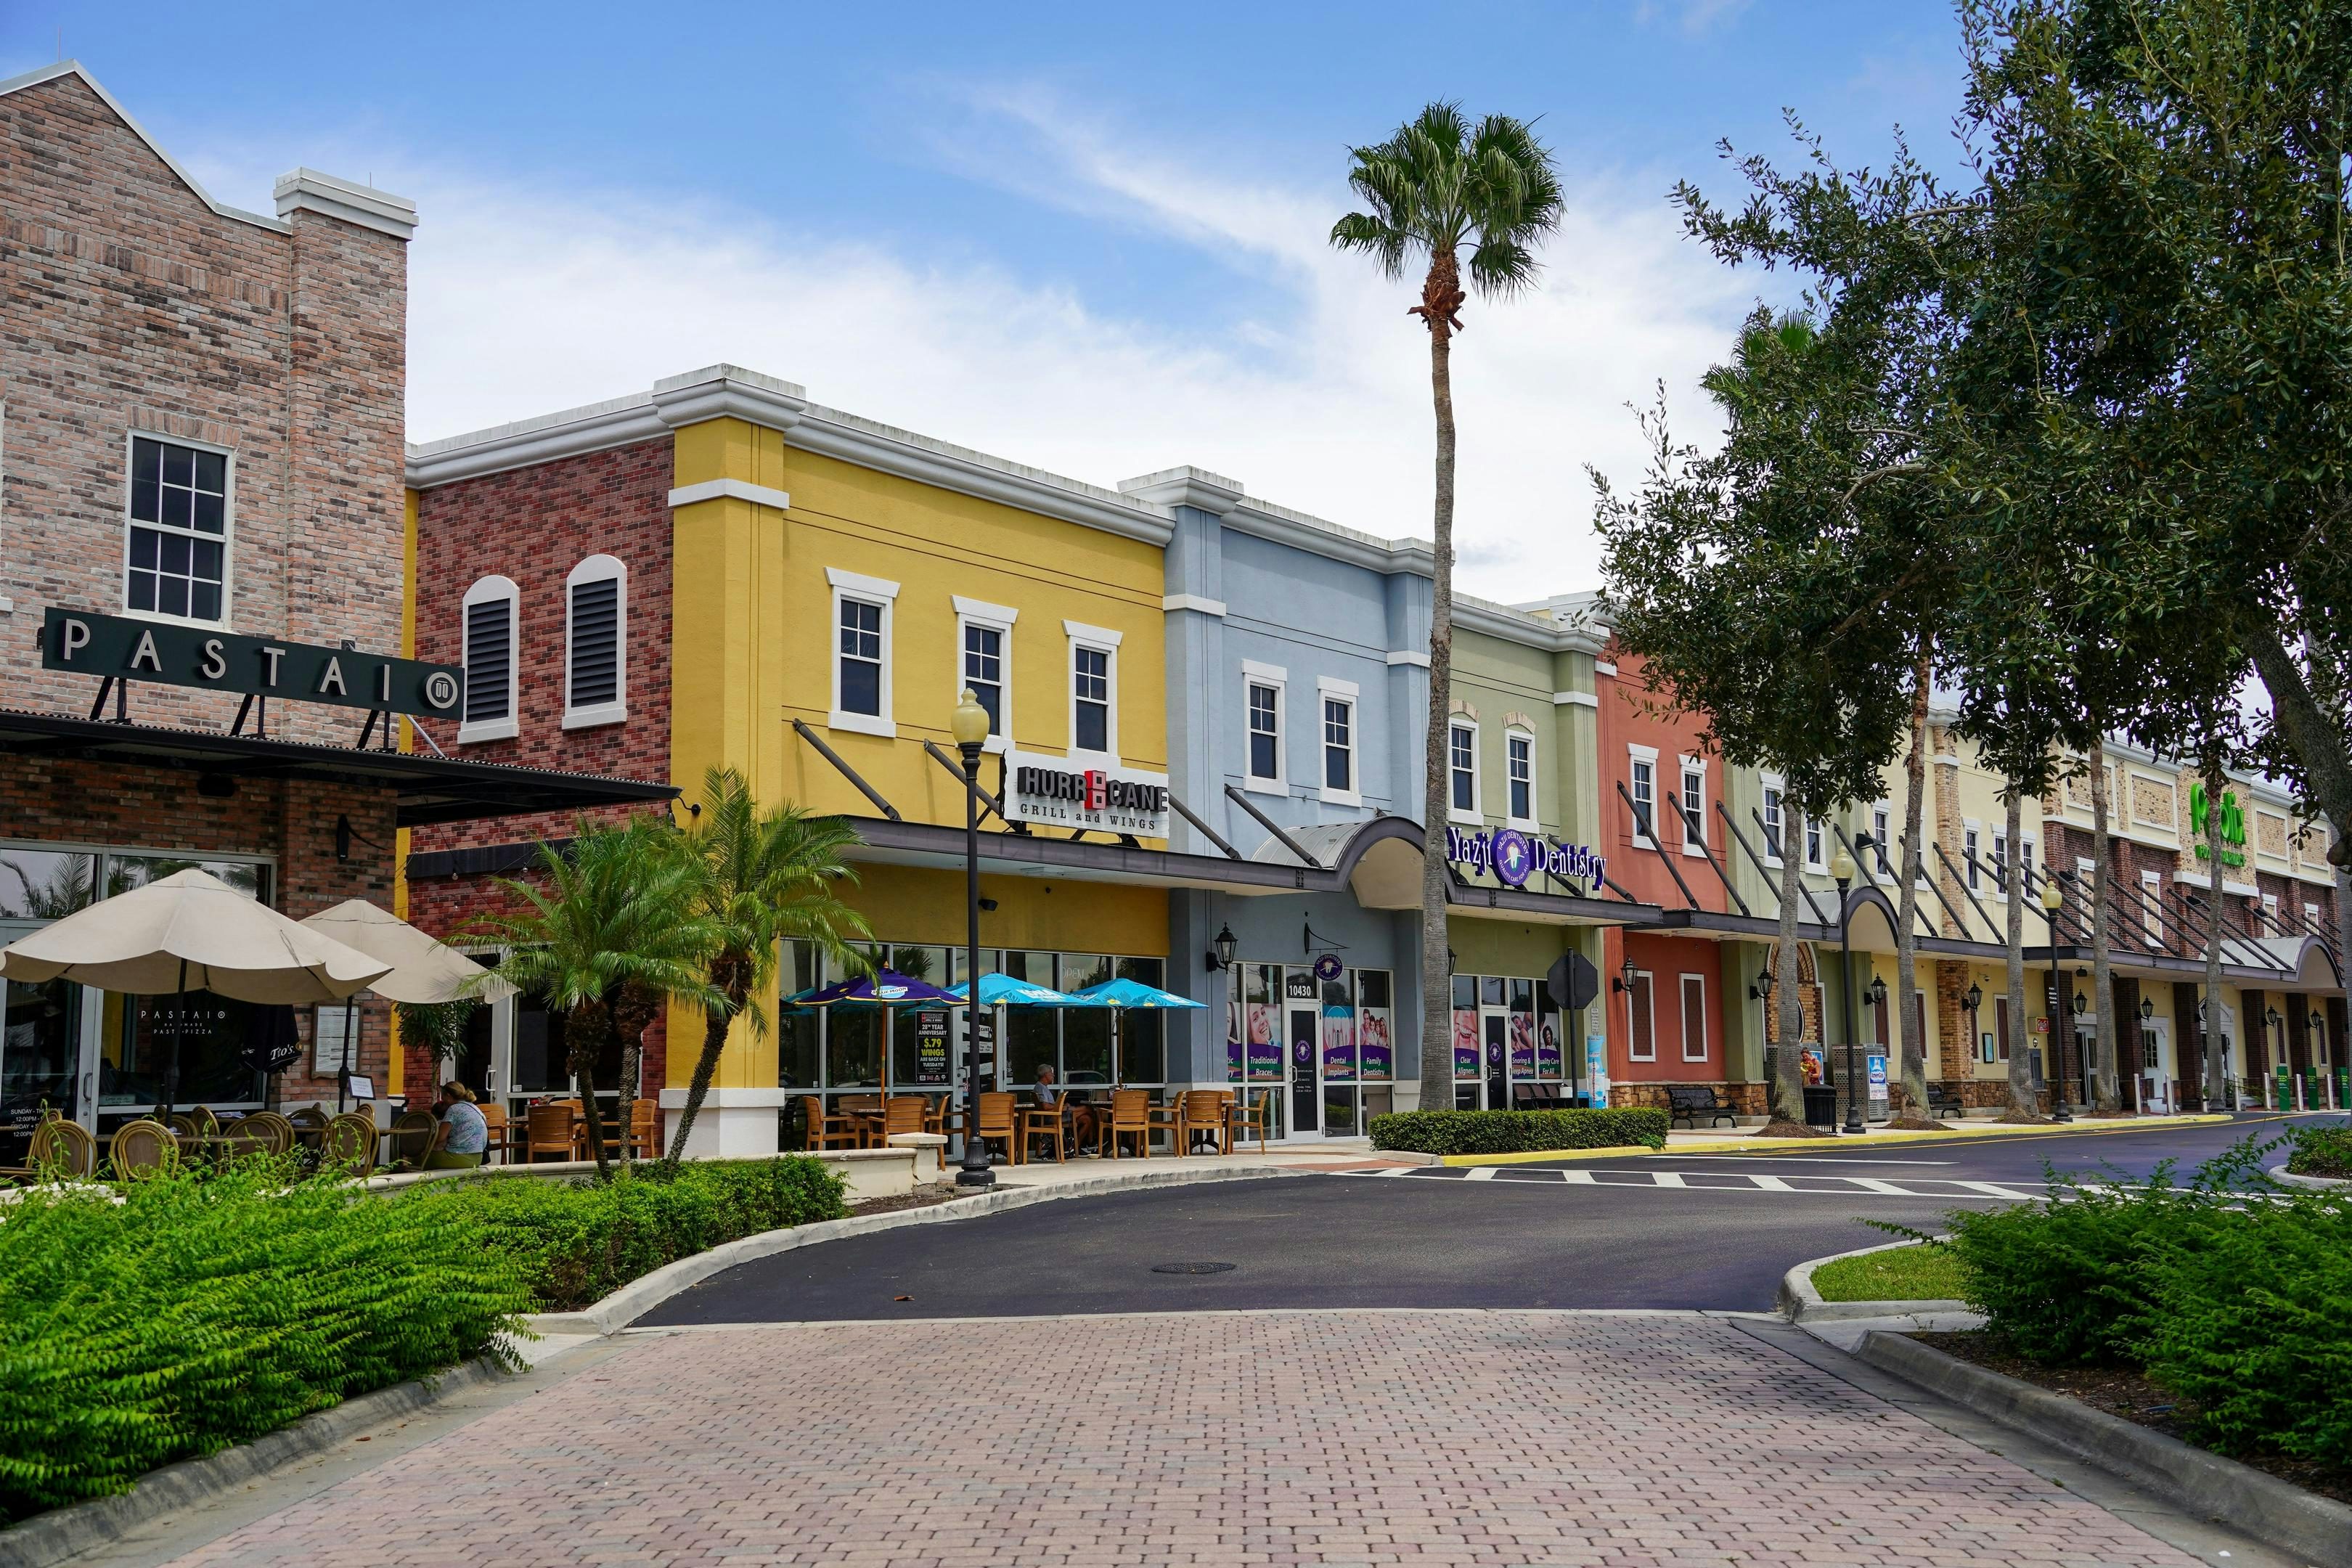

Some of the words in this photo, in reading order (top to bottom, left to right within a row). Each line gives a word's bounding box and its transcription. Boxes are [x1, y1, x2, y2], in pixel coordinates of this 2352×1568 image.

[1020, 804, 1066, 819] GRILL
[1075, 813, 1101, 823] and
[1109, 815, 1155, 830] WINGS
[1506, 831, 1529, 854] DENTISTRY
[1450, 827, 1492, 875] Yazji
[1535, 838, 1607, 889] Dentistry
[1499, 859, 1511, 879] QUALITY
[1289, 984, 1311, 996] 10430
[924, 1037, 942, 1048] $.79
[1366, 1057, 1381, 1066] Family
[1328, 1069, 1349, 1077] Implants
[1521, 1067, 1534, 1076] Apnea
